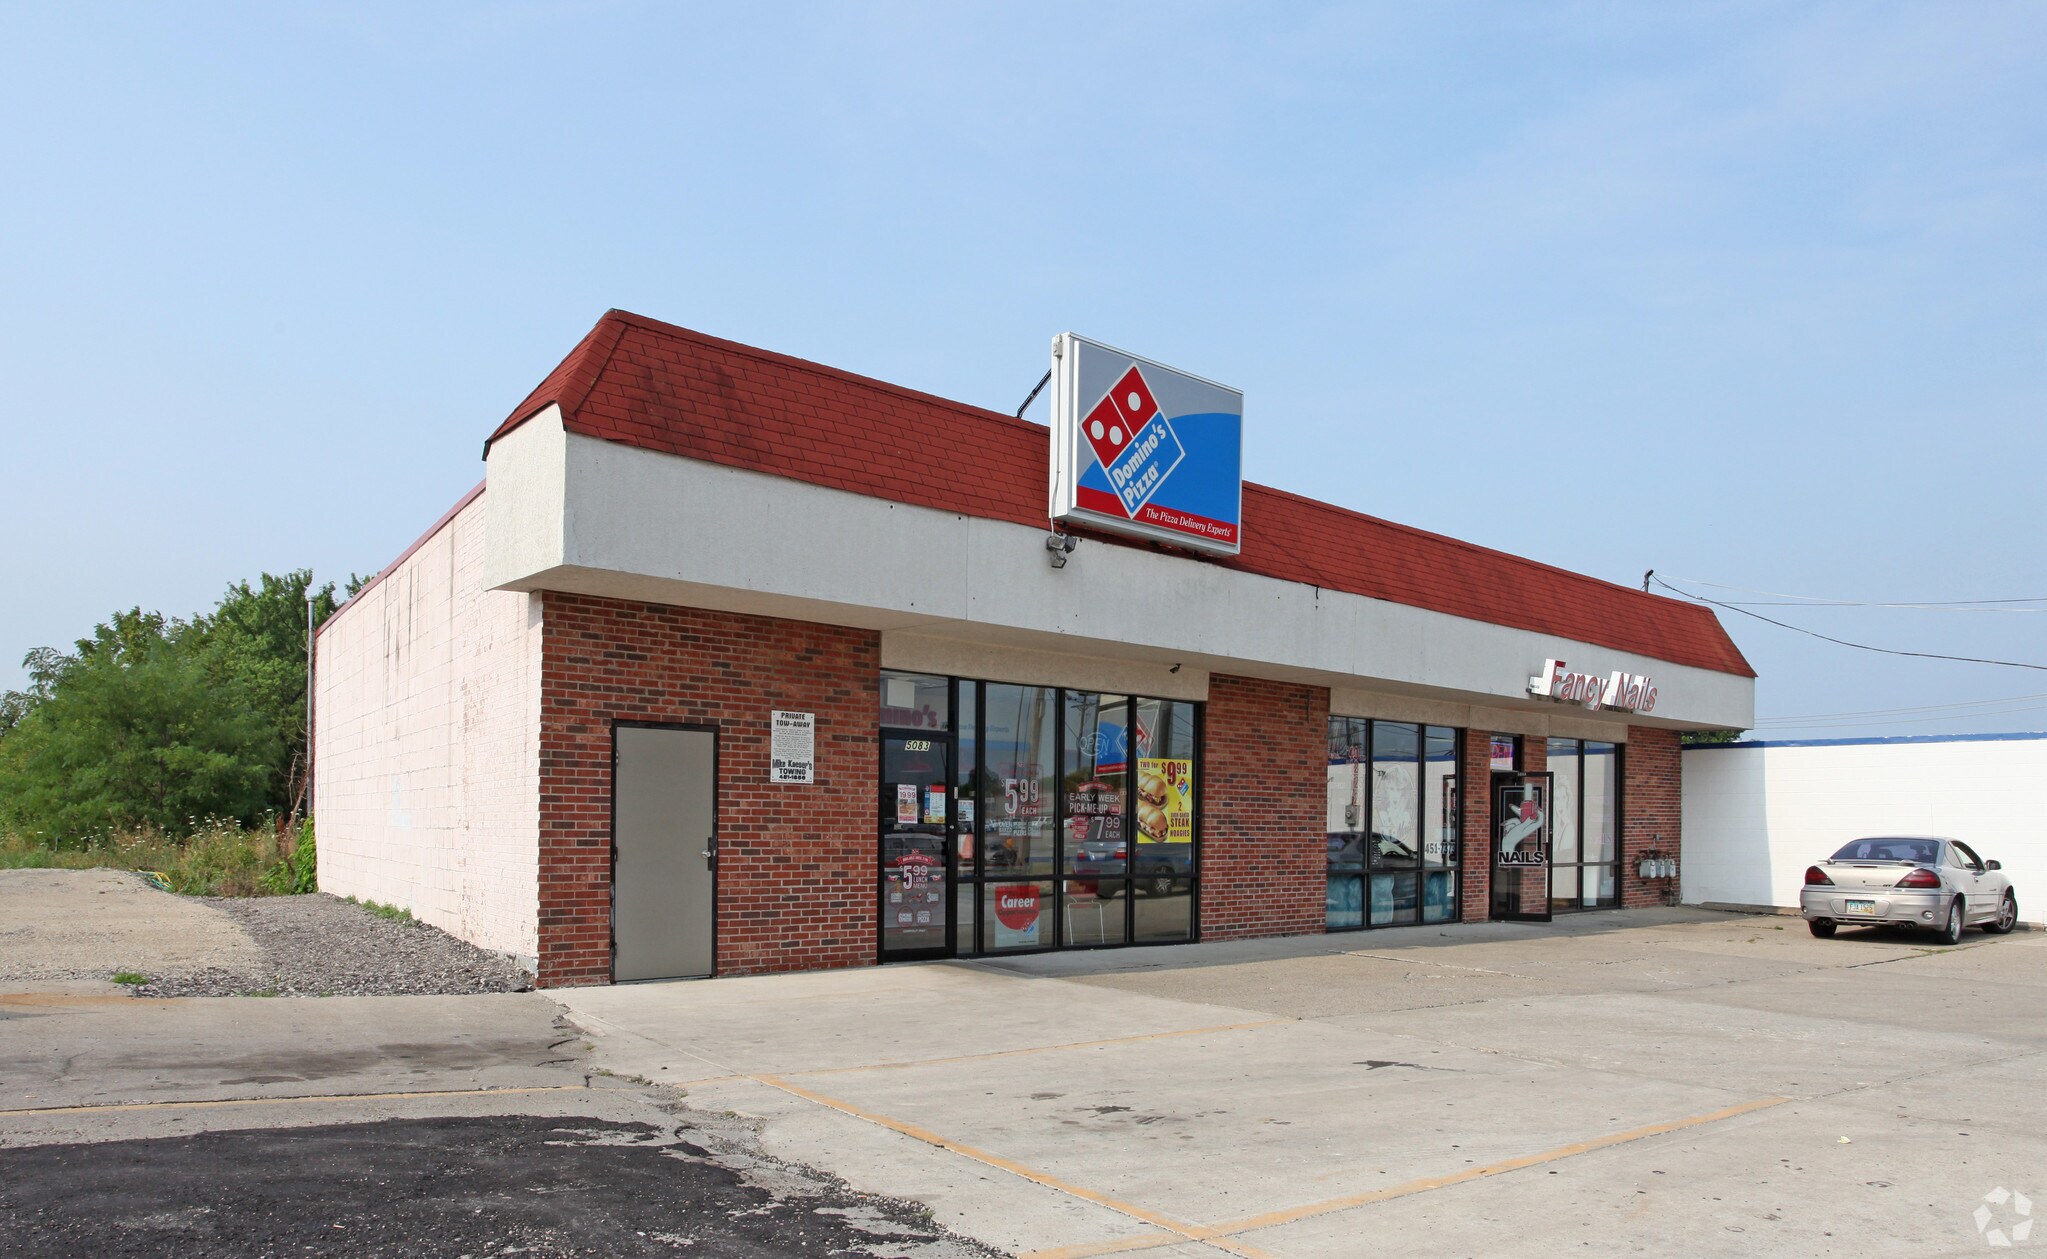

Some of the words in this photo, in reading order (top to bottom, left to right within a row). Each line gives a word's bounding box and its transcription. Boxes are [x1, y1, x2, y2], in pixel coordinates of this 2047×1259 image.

[1112, 424, 1166, 488] Domino's
[1123, 464, 1159, 508] Pizza
[1146, 508, 1158, 519] The
[1160, 511, 1178, 524] Pizza
[1180, 516, 1206, 533] Delivery
[1207, 523, 1231, 536] Experts
[1548, 659, 1609, 711] Fancy
[1612, 671, 1657, 712] Nails
[781, 712, 805, 720] PRIVATE
[776, 720, 810, 728] TOW-AWAY
[906, 741, 930, 750] 5083
[1070, 793, 1095, 801] EARLY
[1098, 794, 1120, 803] WEEK
[1022, 807, 1037, 815] EACH
[1069, 803, 1108, 814] PICK-ME-UP
[1170, 818, 1189, 828] STEAK
[1499, 851, 1544, 864] NAILS
[1001, 895, 1035, 908] Career
